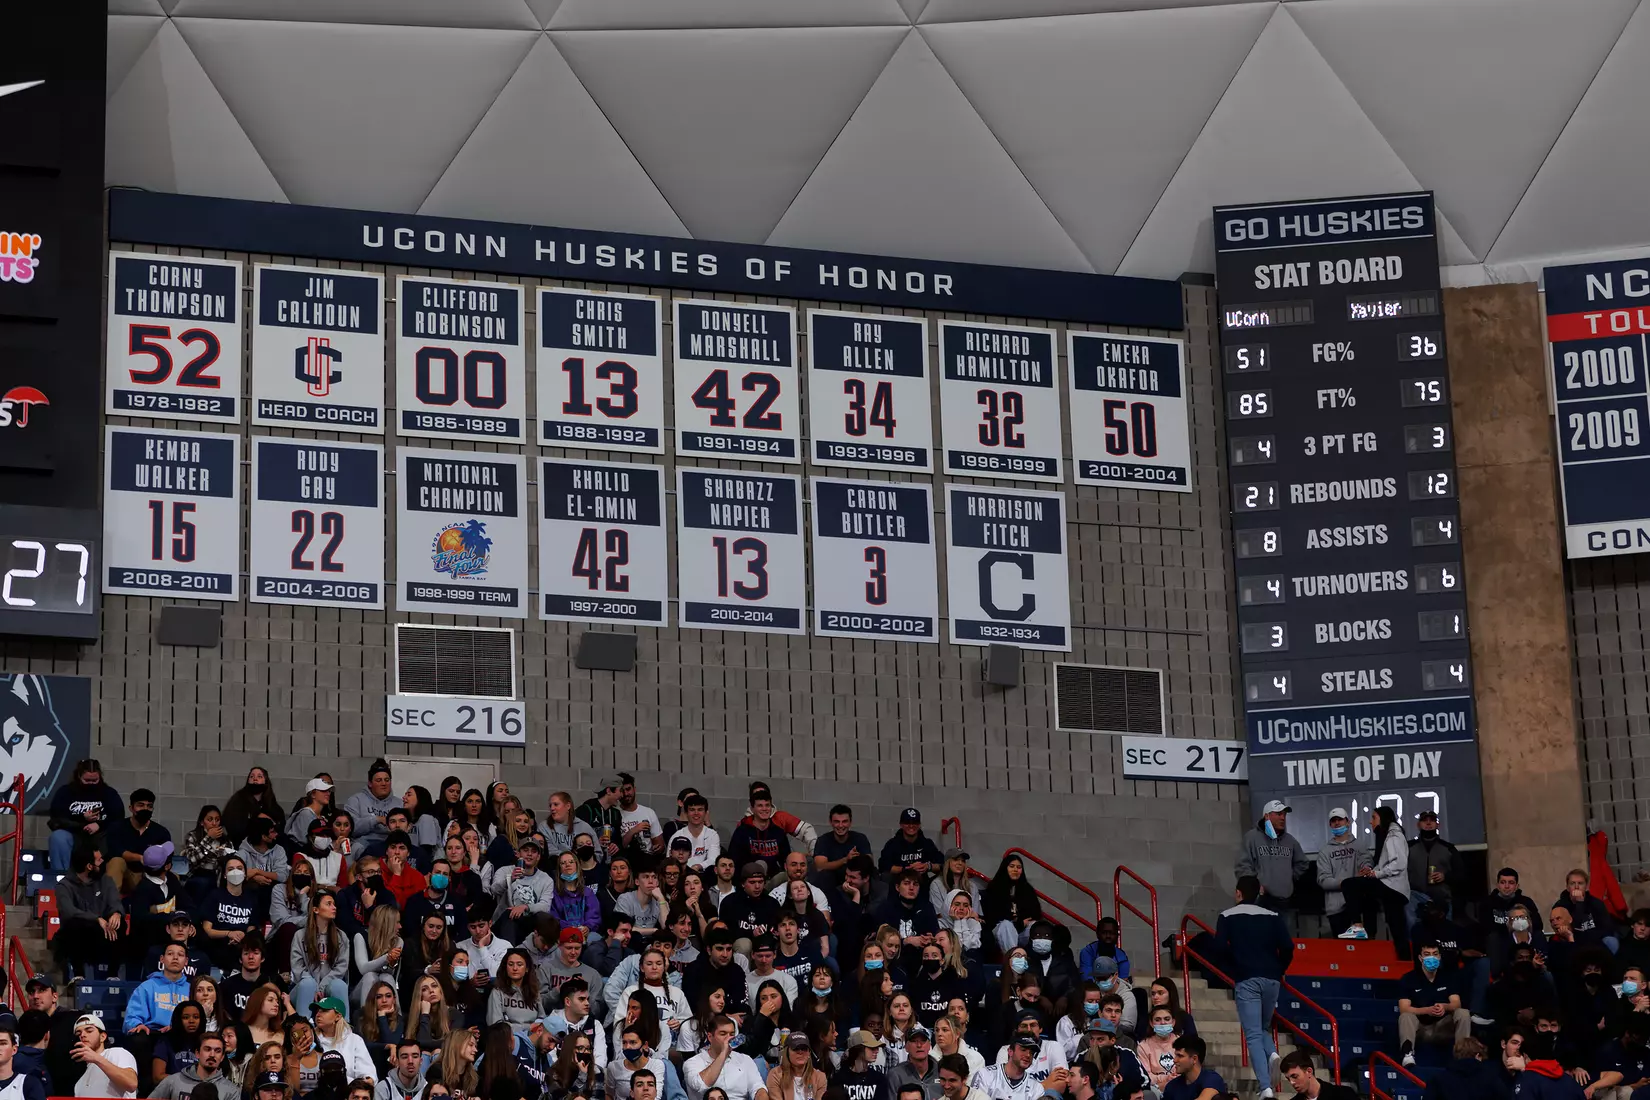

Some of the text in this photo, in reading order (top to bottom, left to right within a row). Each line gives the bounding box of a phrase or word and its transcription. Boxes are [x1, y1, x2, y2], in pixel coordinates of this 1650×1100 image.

[1225, 206, 1424, 241] GO HUSKIES
[363, 225, 953, 296] UCONN HUSKIES OF HONOR
[149, 265, 202, 288] CORNY
[1255, 256, 1402, 289] STAT BOARD
[305, 277, 333, 299] JIM
[423, 287, 497, 312] CLIFFORD
[126, 288, 225, 318] THOMPSON
[278, 300, 359, 328] CALHOUN
[576, 299, 622, 322] CHRIS
[416, 311, 505, 340] ROBINSON
[702, 310, 768, 334] DONYELL
[1226, 310, 1269, 327] UConn
[572, 323, 626, 349] SMITH
[854, 322, 882, 343] RAY
[966, 332, 1029, 355] RICHARD
[129, 324, 221, 389] 52
[691, 334, 780, 362] MARSHALL
[843, 345, 894, 370] ALLEN
[1103, 343, 1149, 365] EMEKA
[1312, 341, 1354, 363] FG%
[1410, 336, 1437, 357] 36
[957, 355, 1040, 382] HAMILTON
[1237, 348, 1264, 369] 51
[1564, 346, 1635, 389] 2000
[416, 346, 507, 409] 00
[562, 357, 638, 419] 13
[1097, 366, 1158, 391] OKAFOR
[691, 369, 782, 431] 42
[1317, 388, 1356, 409] FT%
[1414, 381, 1440, 401] 75
[127, 394, 220, 412] 1978-1982
[262, 403, 374, 423] HEAD COACH
[844, 379, 896, 438] 34
[1240, 393, 1267, 415] 85
[416, 415, 506, 433] 1985-1989
[977, 389, 1025, 448] 32
[1103, 399, 1157, 458] 50
[1569, 408, 1640, 451] 2009
[556, 425, 645, 442] 1988-1992
[697, 436, 780, 453] 1991-1994
[1304, 432, 1377, 456] 3 PT FG
[1433, 427, 1444, 448] 3
[146, 439, 200, 463] KEMBA
[829, 445, 915, 462] 1993-1996
[1258, 440, 1271, 458] 4
[297, 450, 339, 472] RUDY
[961, 455, 1045, 472] 1996-1999
[1089, 464, 1177, 481] 2001-2004
[136, 464, 209, 491] WALKER
[424, 463, 499, 486] NATIONAL
[573, 469, 629, 492] KHALID
[1428, 473, 1448, 494] 12
[301, 475, 335, 500] GAY
[420, 486, 503, 512] CHAMPION
[704, 478, 774, 501] SHABAZZ
[1246, 486, 1273, 507] 21
[1290, 477, 1397, 504] REBOUNDS
[567, 494, 636, 520] EL-AMIN
[847, 489, 897, 511] CARON
[968, 496, 1042, 521] HARRISON
[710, 503, 770, 528] NAPIER
[842, 512, 905, 537] BUTLER
[149, 500, 196, 563] 15
[442, 523, 465, 532] NCAA
[983, 523, 1029, 547] FITCH
[1307, 524, 1388, 549] ASSISTS
[1439, 521, 1452, 539] 4
[291, 510, 344, 572] 22
[1264, 531, 1276, 552] 8
[432, 545, 477, 570] Final
[451, 555, 490, 580] Four
[572, 528, 629, 592] 42
[712, 536, 768, 600] 13
[2, 540, 89, 607] 27
[123, 572, 218, 589] 2008-2011
[864, 546, 887, 605] 3
[1292, 570, 1408, 597] TURNOVERS
[1442, 568, 1455, 588] 6
[264, 581, 370, 599] 2004-2006
[414, 587, 511, 602] 1998-1999 TEAM
[978, 551, 1036, 622] C
[1267, 580, 1280, 598] 4
[570, 601, 636, 614] 1997-2000
[711, 609, 773, 622] 2010-2014
[828, 615, 925, 632] 2000-2002
[980, 626, 1040, 639] 1932-1934
[1315, 619, 1392, 643] BLOCKS
[1454, 615, 1459, 633] 1
[1271, 626, 1283, 647] 3
[1321, 668, 1393, 692] STEALS
[1450, 664, 1463, 682] 4
[1273, 676, 1286, 694] 4
[391, 705, 522, 736] SEC 216
[1126, 744, 1245, 773] SEC 217
[1283, 751, 1442, 786] TIME OF DAY
[158, 961, 197, 977] UNN
[785, 962, 811, 977] SKIES
[504, 998, 539, 1012] UCONN
[656, 996, 678, 1014] ONN
